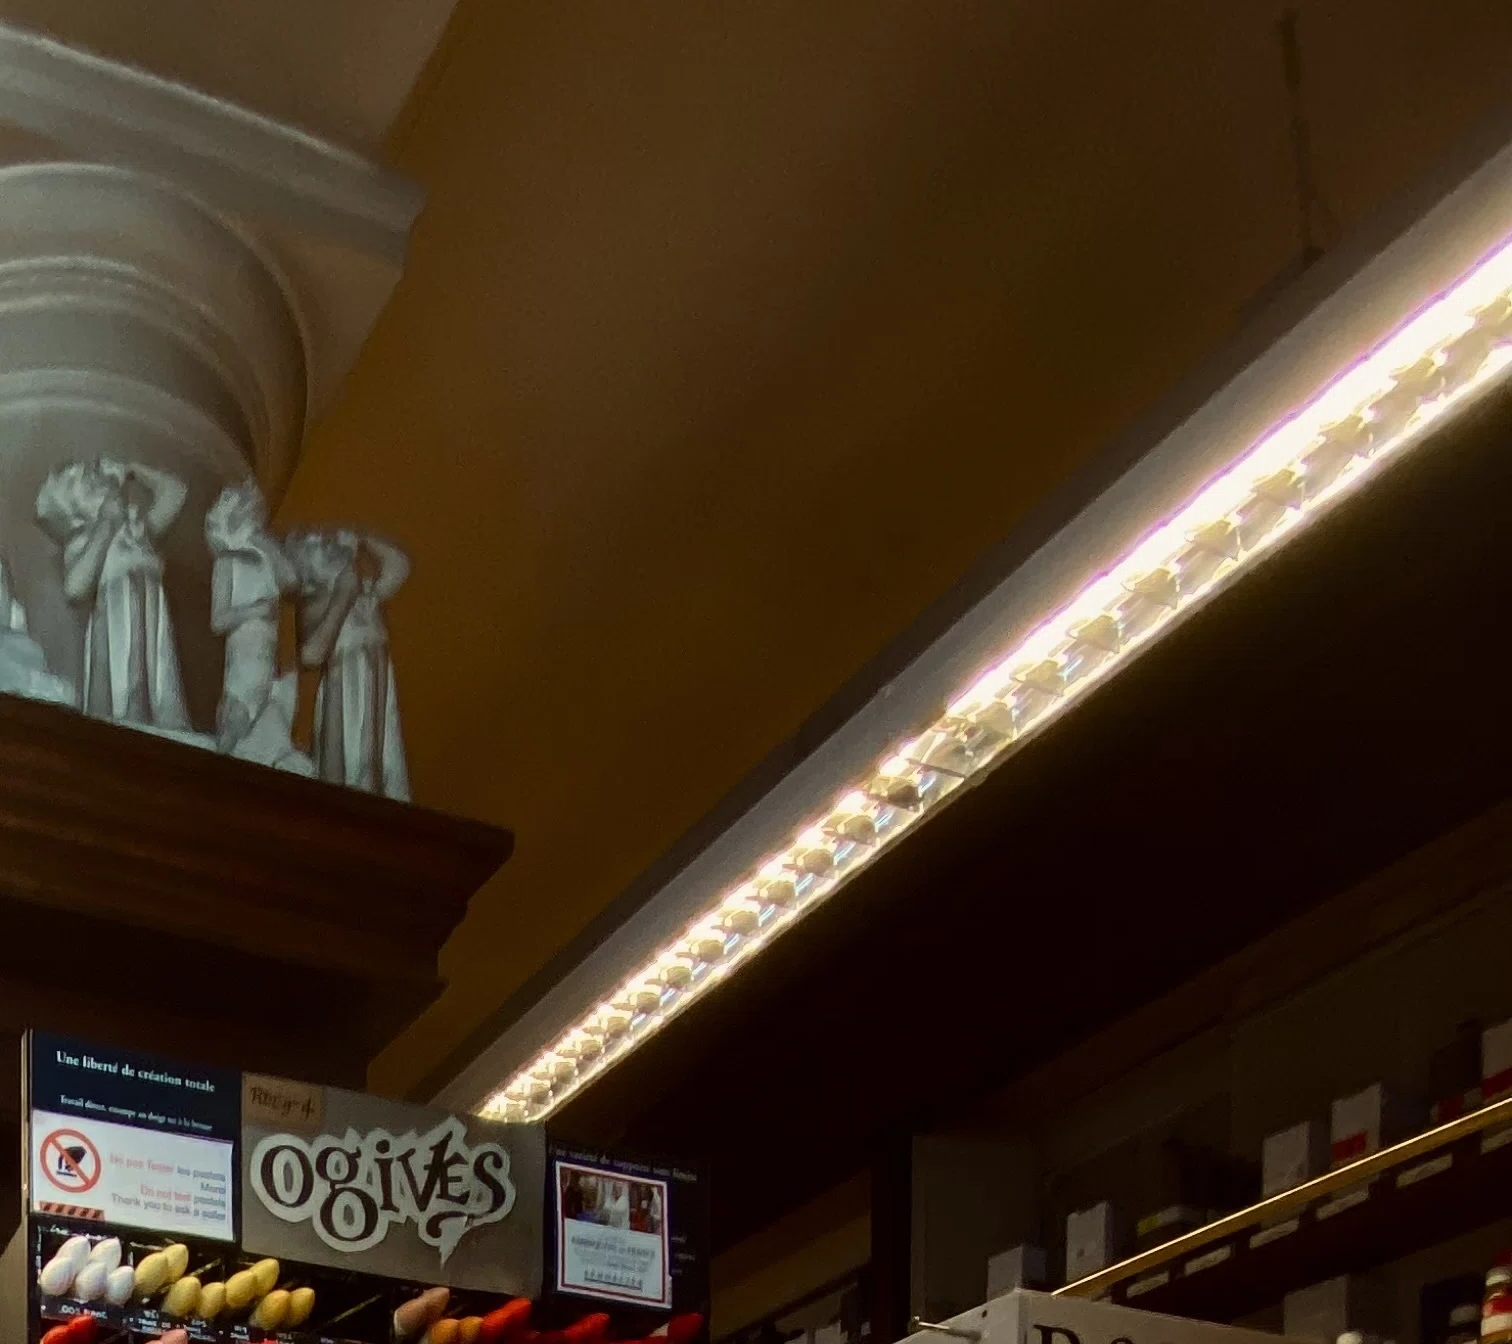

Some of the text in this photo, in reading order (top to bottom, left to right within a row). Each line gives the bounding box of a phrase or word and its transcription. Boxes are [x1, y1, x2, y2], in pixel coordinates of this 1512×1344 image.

[56, 1050, 215, 1093] Une liberté de création totale
[111, 1192, 173, 1212] Thank you to
